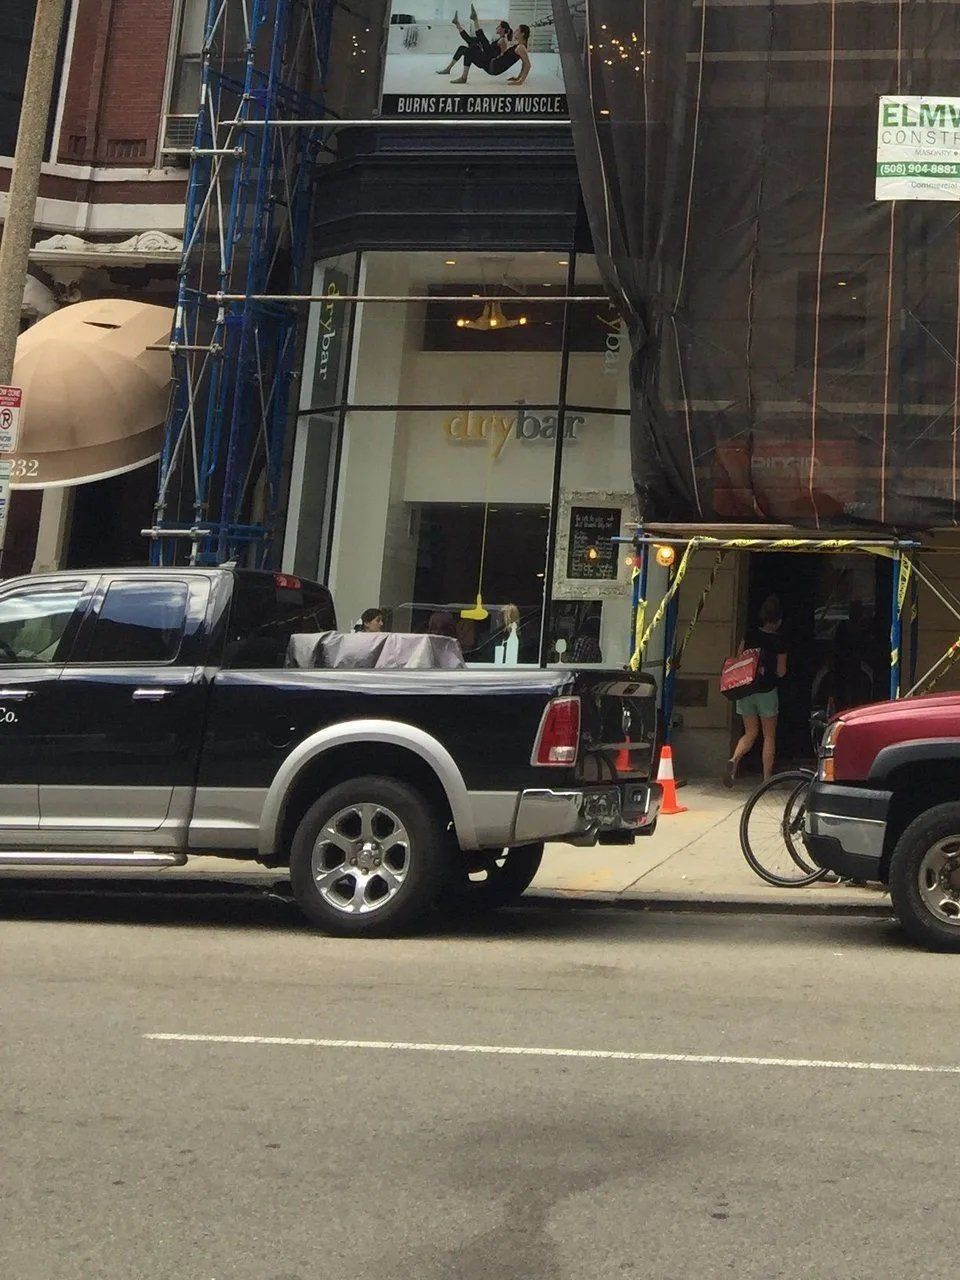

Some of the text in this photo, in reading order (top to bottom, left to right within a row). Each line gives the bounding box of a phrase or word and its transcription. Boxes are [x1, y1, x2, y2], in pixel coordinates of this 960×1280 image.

[398, 97, 565, 113] BURNS FAT. CARVES MUSCLE.
[880, 164, 906, 175] (508)
[319, 282, 338, 380] drybar
[443, 401, 585, 459] drybar
[0, 707, 18, 723] Co.
